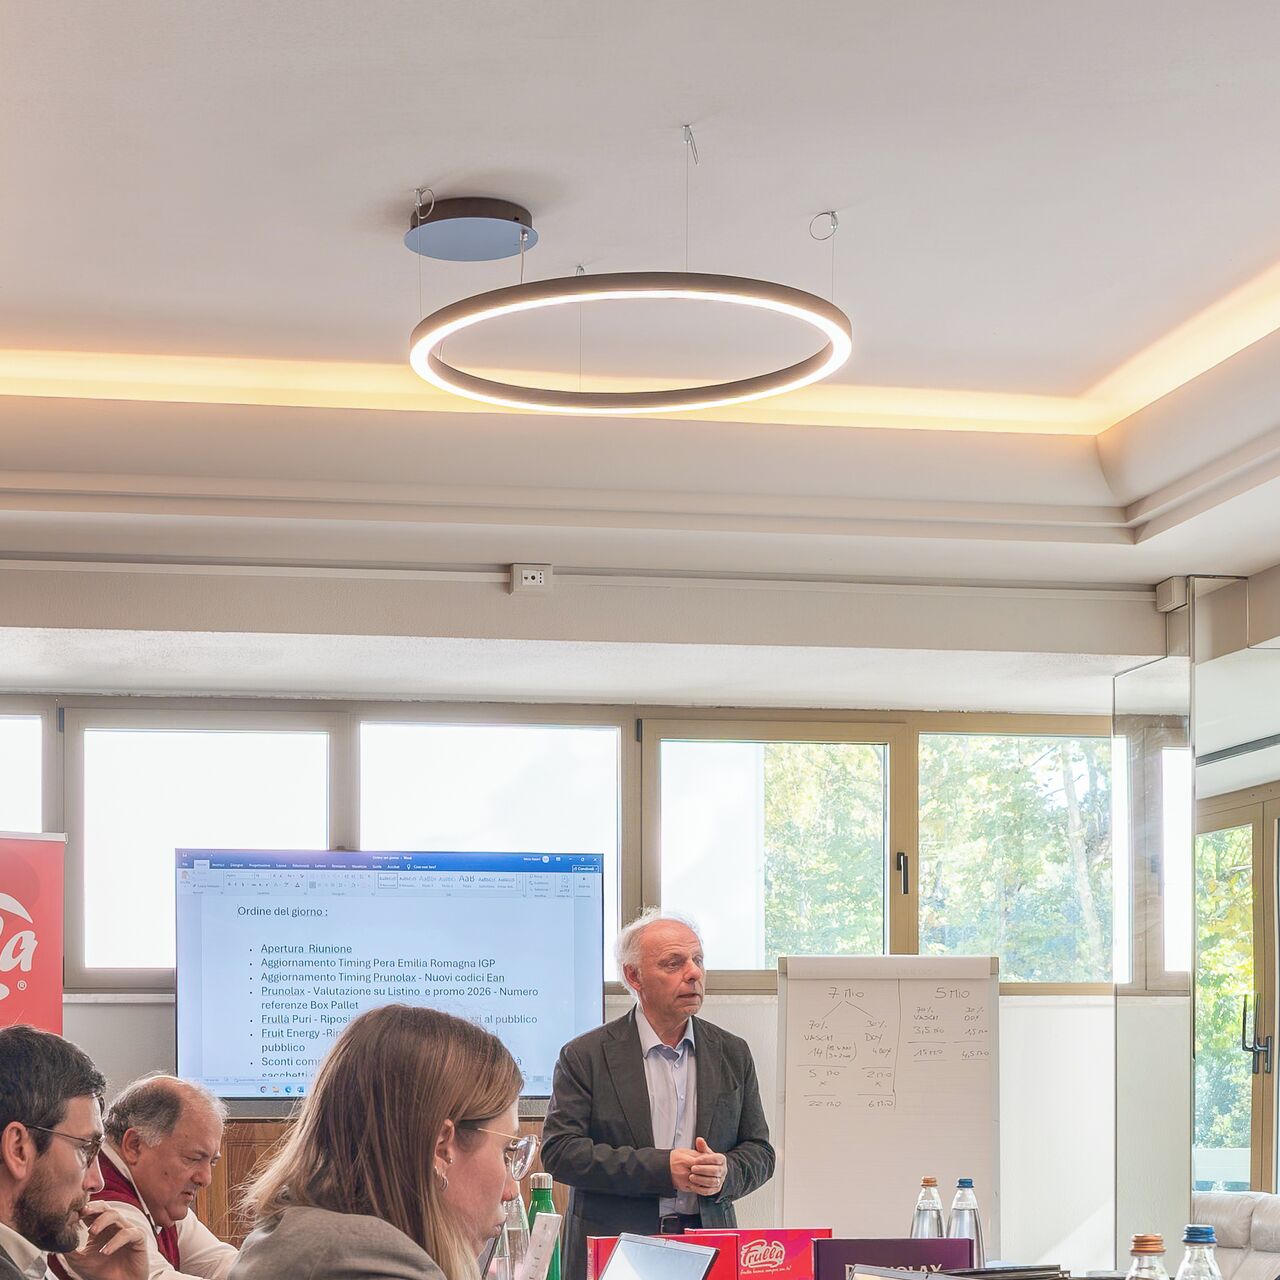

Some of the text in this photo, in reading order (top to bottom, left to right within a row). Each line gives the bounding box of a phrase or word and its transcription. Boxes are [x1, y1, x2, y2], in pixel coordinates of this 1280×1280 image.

[238, 906, 271, 916] Ordine
[274, 906, 289, 916] del
[292, 906, 322, 918] giorno
[261, 944, 352, 955] Apertura Riunione
[261, 958, 496, 970] Aggiornamento Timing Pera Emilia Romagna IGP
[261, 972, 336, 983] Aggiornamento
[339, 972, 371, 983] Timing
[373, 973, 417, 983] Prunolax
[424, 973, 452, 982] Nuovi
[455, 972, 484, 982] codici
[487, 973, 505, 983] Ean
[261, 986, 305, 996] Prunolax
[313, 986, 371, 996] Valutazione
[374, 988, 385, 996] su
[388, 987, 420, 996] Listino
[433, 989, 465, 998] promo
[467, 987, 491, 996] 2026
[499, 987, 538, 996] Numero
[828, 986, 839, 999] 7
[934, 986, 947, 999] 5
[261, 1000, 359, 1010] referenze Box Pallet
[261, 1015, 290, 1024] Frullà
[292, 1015, 311, 1024] Puri
[484, 1015, 493, 1024] al
[495, 1015, 538, 1025] pubblico
[261, 1029, 284, 1038] Fruit
[287, 1029, 320, 1040] Energy
[261, 1043, 305, 1053] pubblico
[261, 1057, 293, 1067] Sconti
[741, 1239, 785, 1267] Frullà
